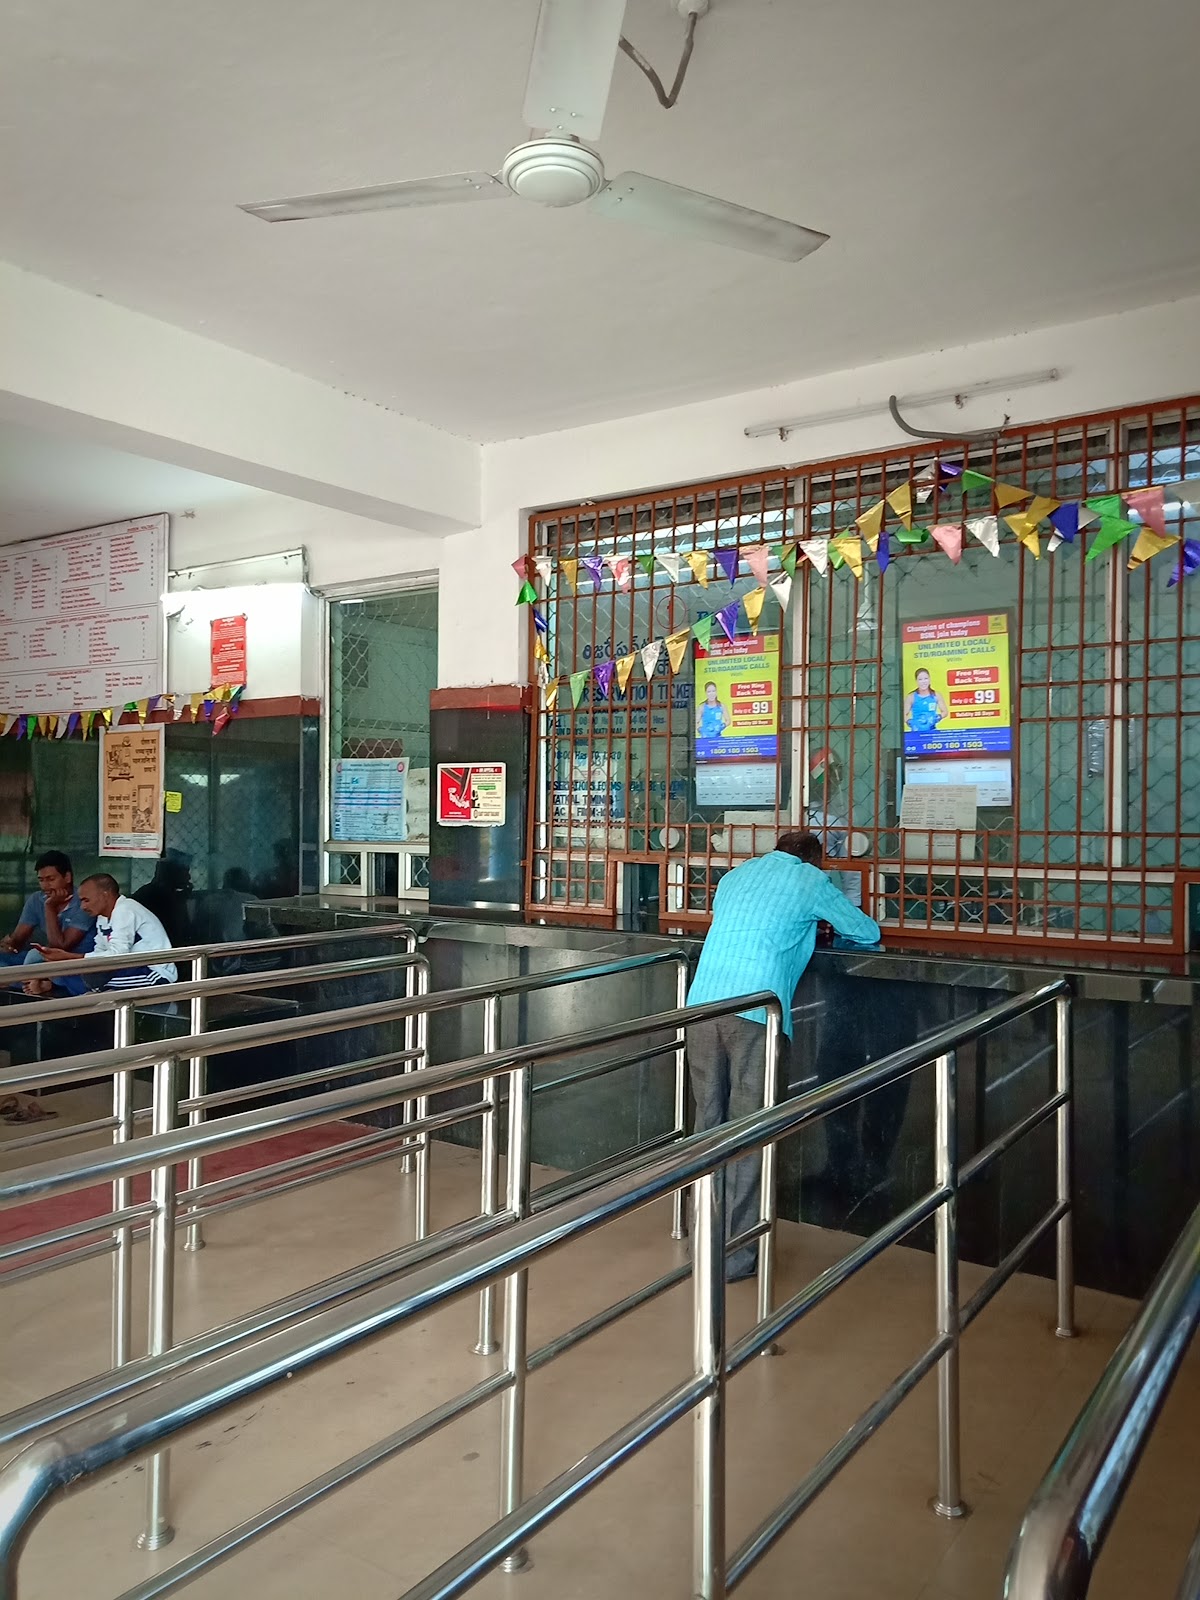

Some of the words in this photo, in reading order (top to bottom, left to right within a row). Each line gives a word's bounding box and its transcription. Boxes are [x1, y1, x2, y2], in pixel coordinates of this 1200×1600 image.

[907, 624, 937, 633] Champion
[946, 620, 981, 629] champions
[950, 629, 968, 637] today
[918, 642, 960, 650] UNLIMITED
[962, 638, 992, 646] LOCAL/
[914, 648, 968, 658] STD/ROAMING
[970, 646, 996, 654] CALLS
[704, 664, 748, 673] STD/ROAMING
[749, 662, 770, 670] CALLS
[708, 657, 741, 666] UNLIMITED
[974, 690, 995, 703] 99
[752, 701, 768, 713] 99
